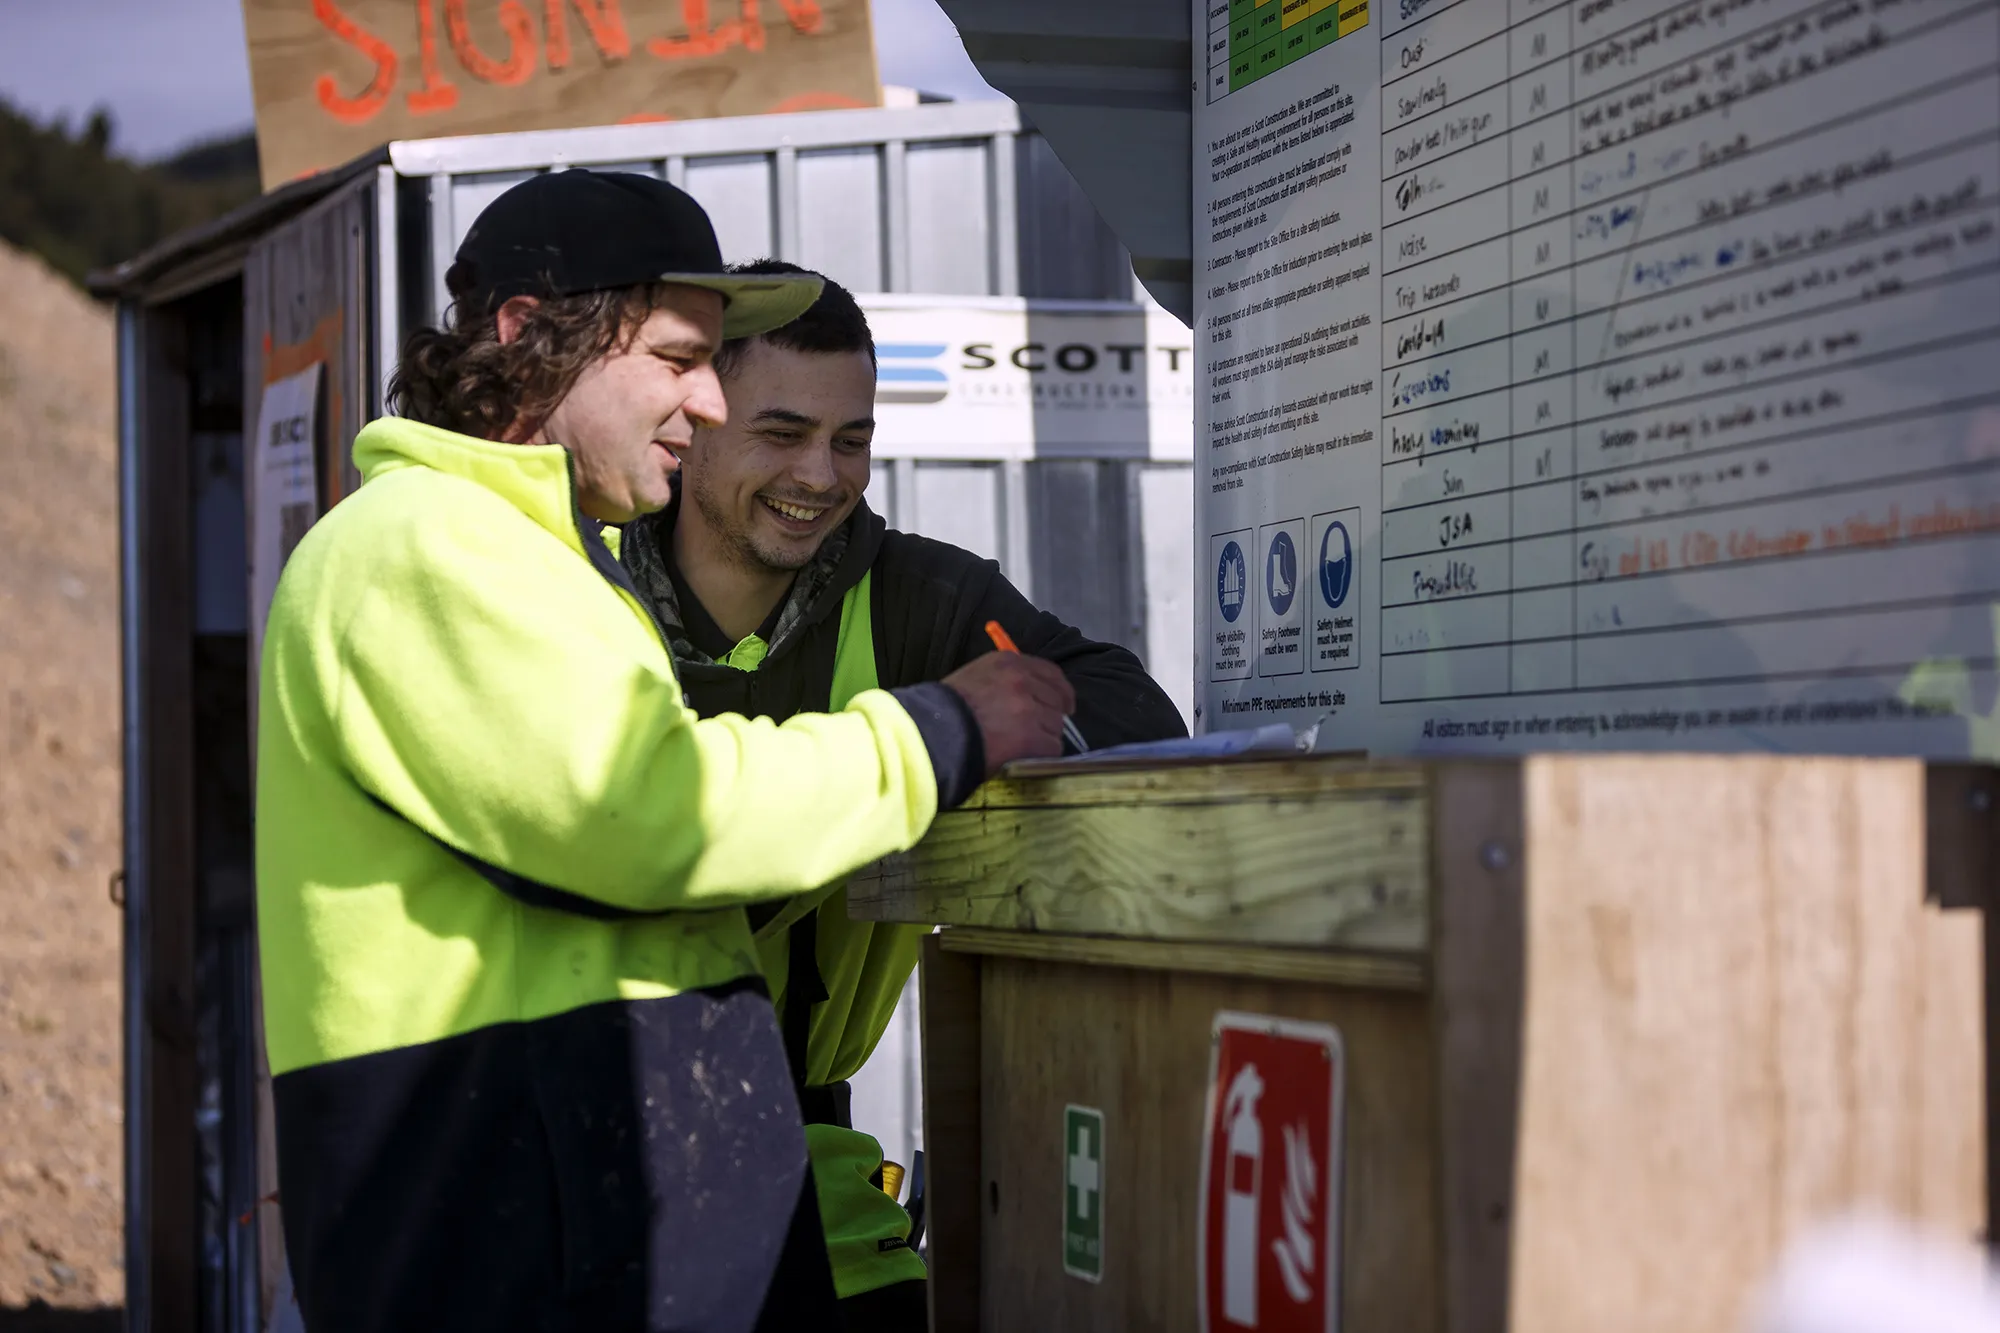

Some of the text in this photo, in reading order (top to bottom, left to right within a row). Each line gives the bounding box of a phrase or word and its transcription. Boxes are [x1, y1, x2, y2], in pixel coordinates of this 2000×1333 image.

[1225, 130, 1236, 145] about
[1241, 125, 1251, 137] enter
[1254, 117, 1264, 131] Scott
[1264, 108, 1288, 126] Construction
[1288, 103, 1297, 115] site.
[1312, 84, 1334, 104] committed
[1212, 153, 1225, 167] creating
[1245, 136, 1259, 152] Healthy
[1260, 130, 1276, 144] working
[1276, 117, 1300, 137] environment
[1313, 106, 1329, 123] persons
[1344, 94, 1354, 106] site.
[1220, 161, 1242, 178] co-operation
[1250, 148, 1271, 165] compliance
[1288, 136, 1299, 148] items
[1300, 128, 1311, 143] listed
[1311, 125, 1324, 138] below
[1217, 195, 1231, 211] persons
[1231, 189, 1246, 203] entering
[1254, 176, 1277, 193] construction
[1301, 159, 1316, 173] familiar
[1325, 147, 1340, 163] comply
[1218, 205, 1241, 225] requirements
[1246, 199, 1256, 212] Scott
[1256, 191, 1279, 208] Construction
[1280, 185, 1289, 198] staff
[1306, 174, 1318, 188] safety
[1318, 166, 1341, 185] procedures
[1211, 226, 1232, 242] instructions
[1232, 223, 1242, 236] given
[1242, 217, 1253, 230] while
[1259, 212, 1267, 224] site.
[1224, 328, 1232, 339] site.
[962, 343, 1190, 373] SCOTT
[1219, 460, 1247, 475] non-compliance
[1257, 454, 1266, 466] Scott
[1267, 450, 1290, 464] Construction
[1290, 446, 1303, 459] Safety
[1303, 443, 1315, 455] Rules
[1325, 437, 1337, 450] result
[1350, 430, 1373, 444] immediate
[1212, 479, 1226, 492] removal
[1440, 512, 1473, 547] JSA
[1262, 627, 1301, 642] Safety Footwear
[1317, 616, 1353, 632] Safety Helmet
[1216, 630, 1245, 646] High visibility
[1264, 646, 1277, 655] must
[1285, 644, 1298, 653] worn
[1317, 634, 1330, 645] must
[1339, 634, 1352, 643] worn
[1222, 644, 1240, 657] clothing
[1327, 644, 1349, 661] required
[1216, 660, 1226, 670] must
[1235, 660, 1246, 668] worn
[1222, 690, 1345, 714] Minimum PPE requirements for this site
[1422, 718, 1434, 738] All
[1436, 718, 1466, 738] visitors
[1467, 719, 1489, 736] must
[1492, 716, 1510, 741] sign
[1513, 715, 1522, 734] in
[1525, 715, 1552, 735] when
[1555, 712, 1596, 740] entering
